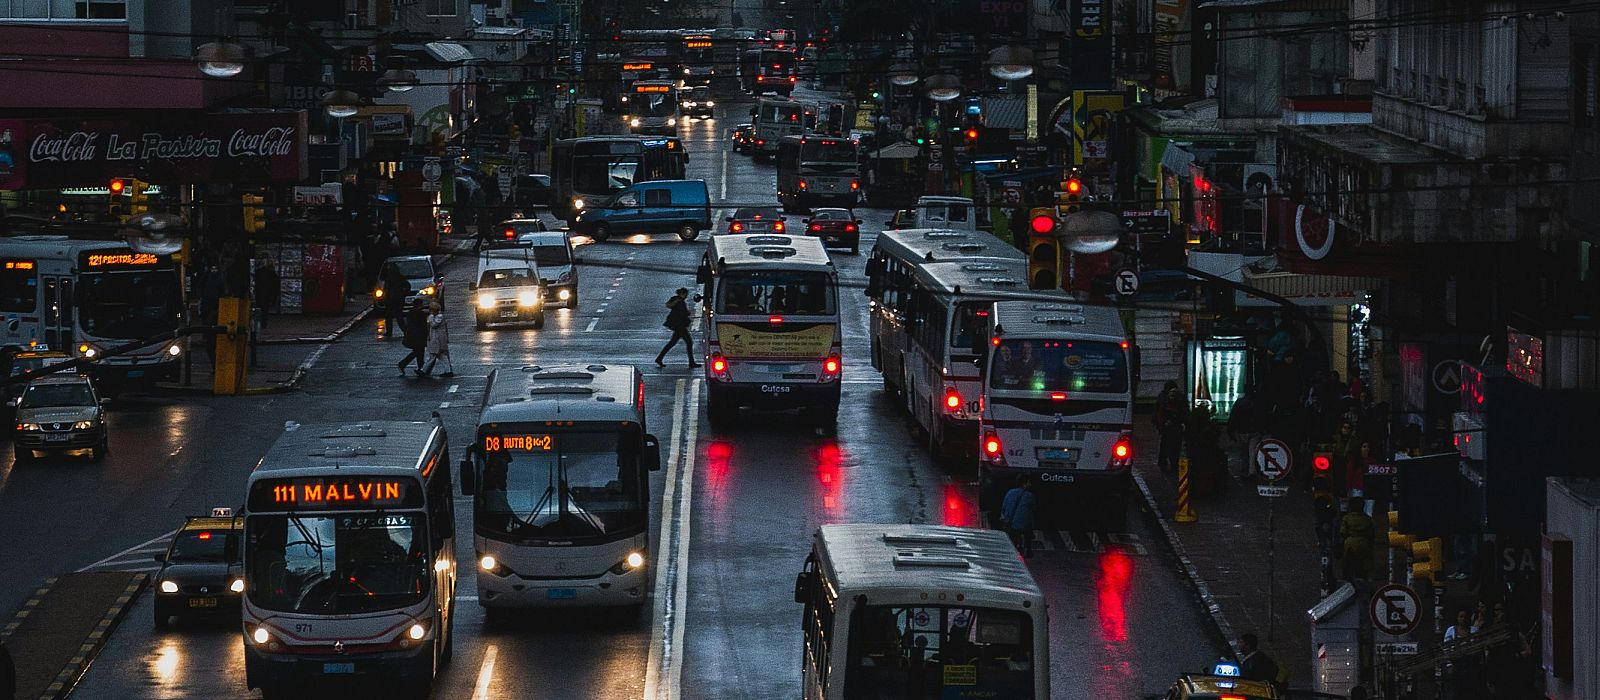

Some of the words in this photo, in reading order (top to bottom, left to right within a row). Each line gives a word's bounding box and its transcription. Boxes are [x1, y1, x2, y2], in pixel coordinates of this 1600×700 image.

[107, 134, 137, 160] La
[141, 132, 222, 159] Pasiva
[761, 384, 790, 393] Cutcsa
[486, 437, 500, 451] D8
[503, 437, 524, 449] RUTA
[1041, 473, 1074, 482] Cutcsa
[274, 486, 297, 502] 111
[304, 483, 399, 502] MALVIN
[296, 623, 312, 632] 971
